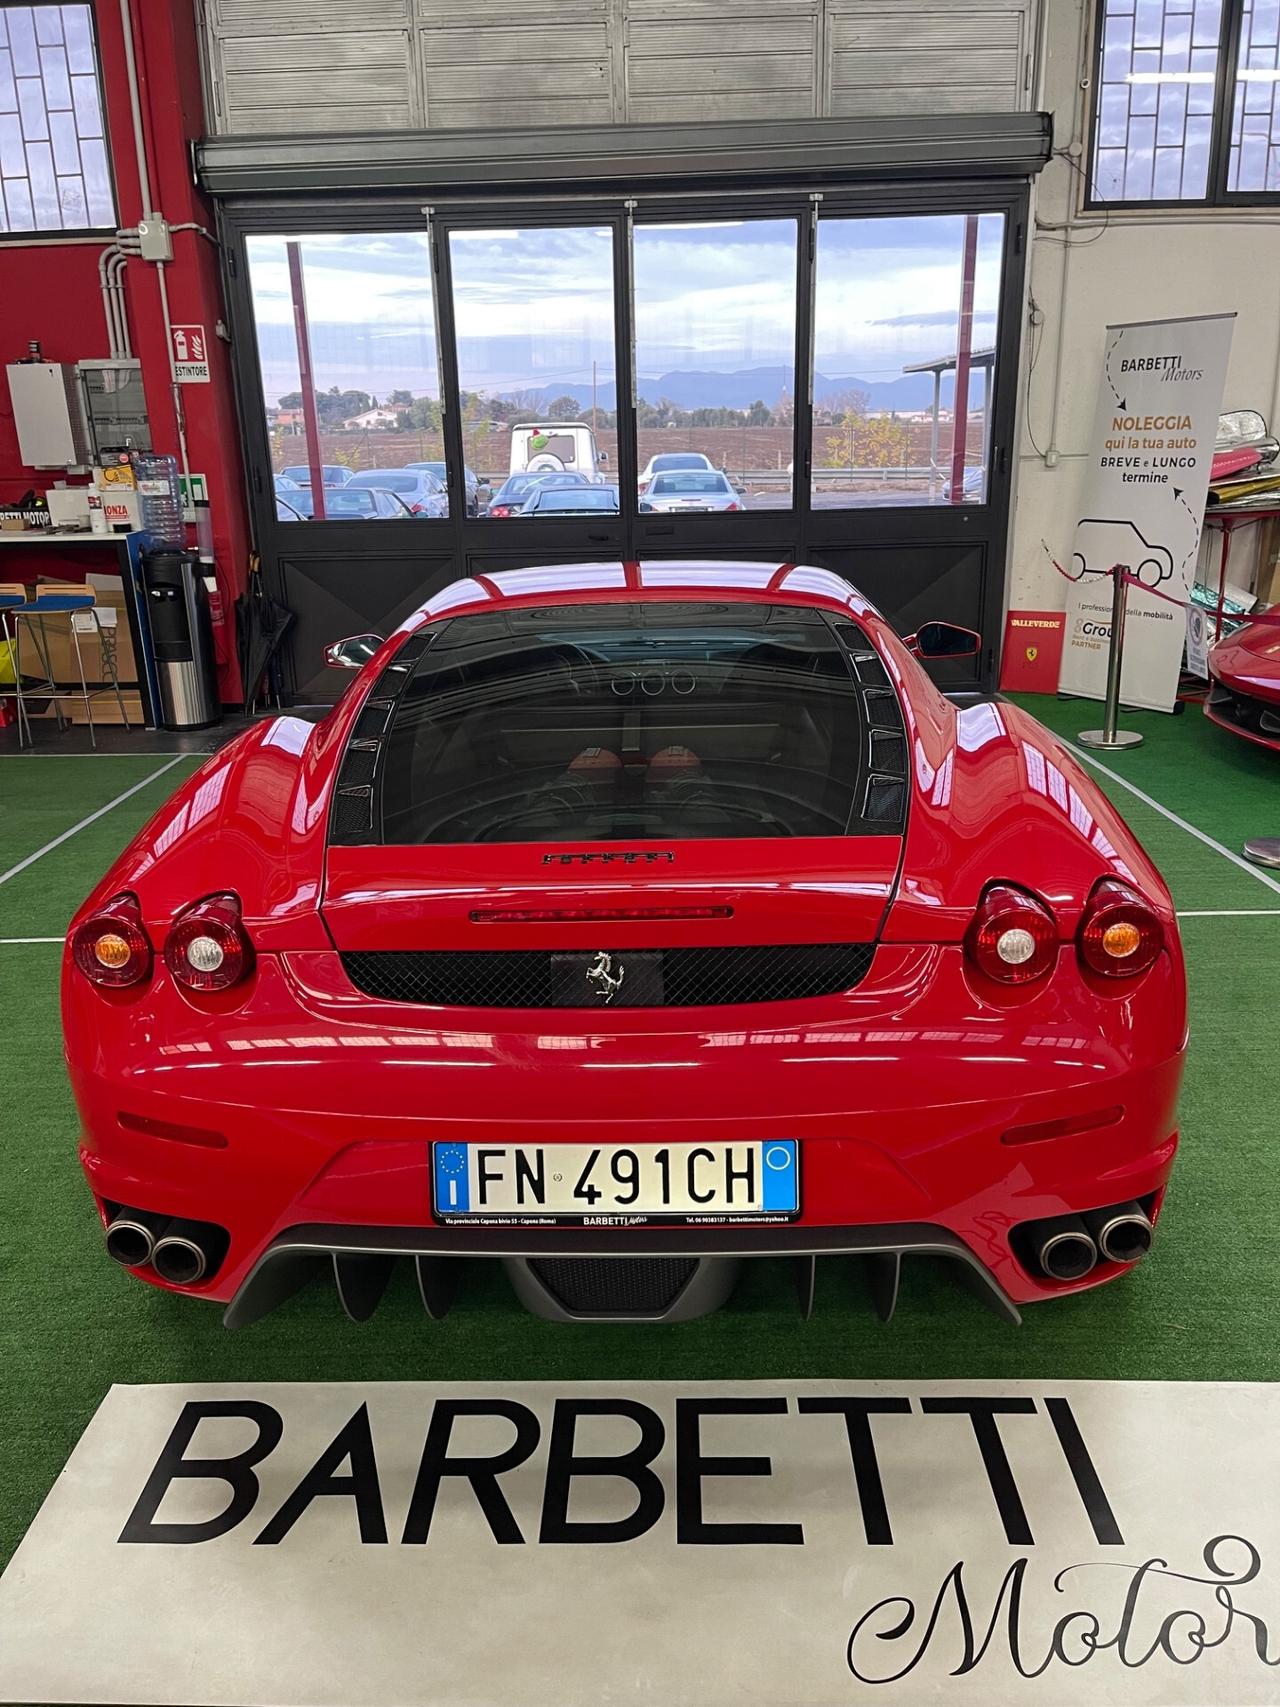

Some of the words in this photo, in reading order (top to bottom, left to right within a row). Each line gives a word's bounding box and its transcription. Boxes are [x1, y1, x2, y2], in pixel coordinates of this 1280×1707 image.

[175, 366, 208, 377] ESTINTORE
[1121, 356, 1182, 372] BARBETTI
[1161, 367, 1204, 382] Motors
[1112, 415, 1192, 431] NOLEGGIA
[1105, 436, 1125, 452] qui
[1128, 437, 1139, 449] la
[1142, 437, 1164, 449] tua
[1167, 437, 1197, 449] auto
[1100, 457, 1141, 467] BREVE
[1143, 460, 1150, 468] e
[1153, 458, 1197, 468] LUNGO
[1122, 471, 1169, 483] termine
[477, 1148, 545, 1205] FN
[573, 1147, 755, 1205] 491CH
[583, 1216, 628, 1225] BARBETTI
[116, 1396, 1125, 1545] BARBETTI
